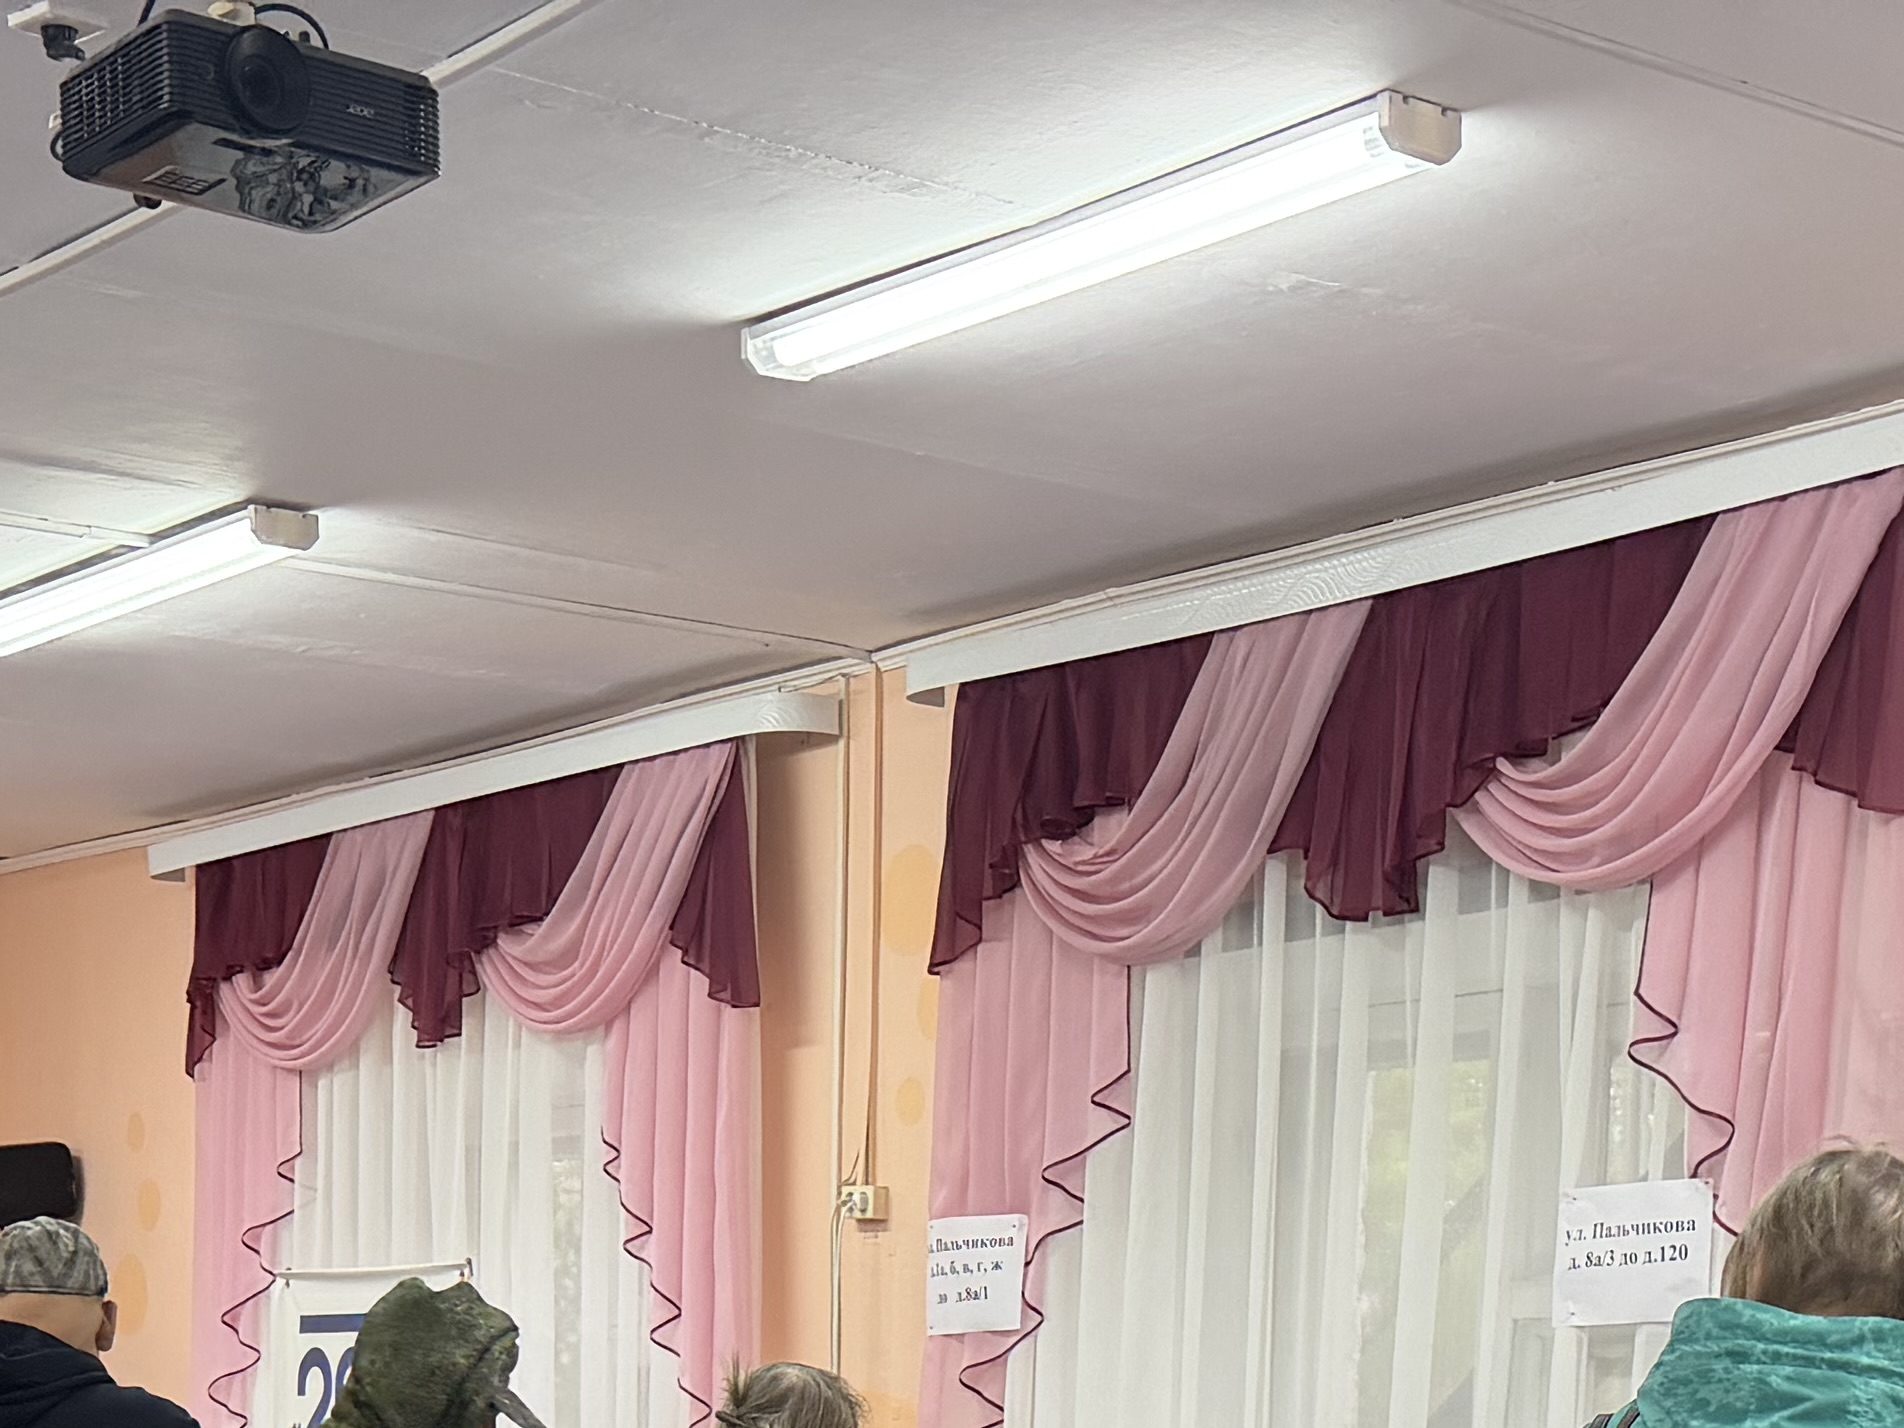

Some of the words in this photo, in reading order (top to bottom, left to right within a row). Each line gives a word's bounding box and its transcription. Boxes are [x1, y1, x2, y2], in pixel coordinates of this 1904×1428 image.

[936, 1236, 1014, 1253] Пальчикова
[1565, 1229, 1587, 1246] ул.
[1592, 1219, 1696, 1240] Пальчикова
[1568, 1256, 1581, 1271] д.
[1585, 1249, 1615, 1268] 8а/3
[1618, 1251, 1638, 1267] до
[1642, 1243, 1689, 1265] д.120
